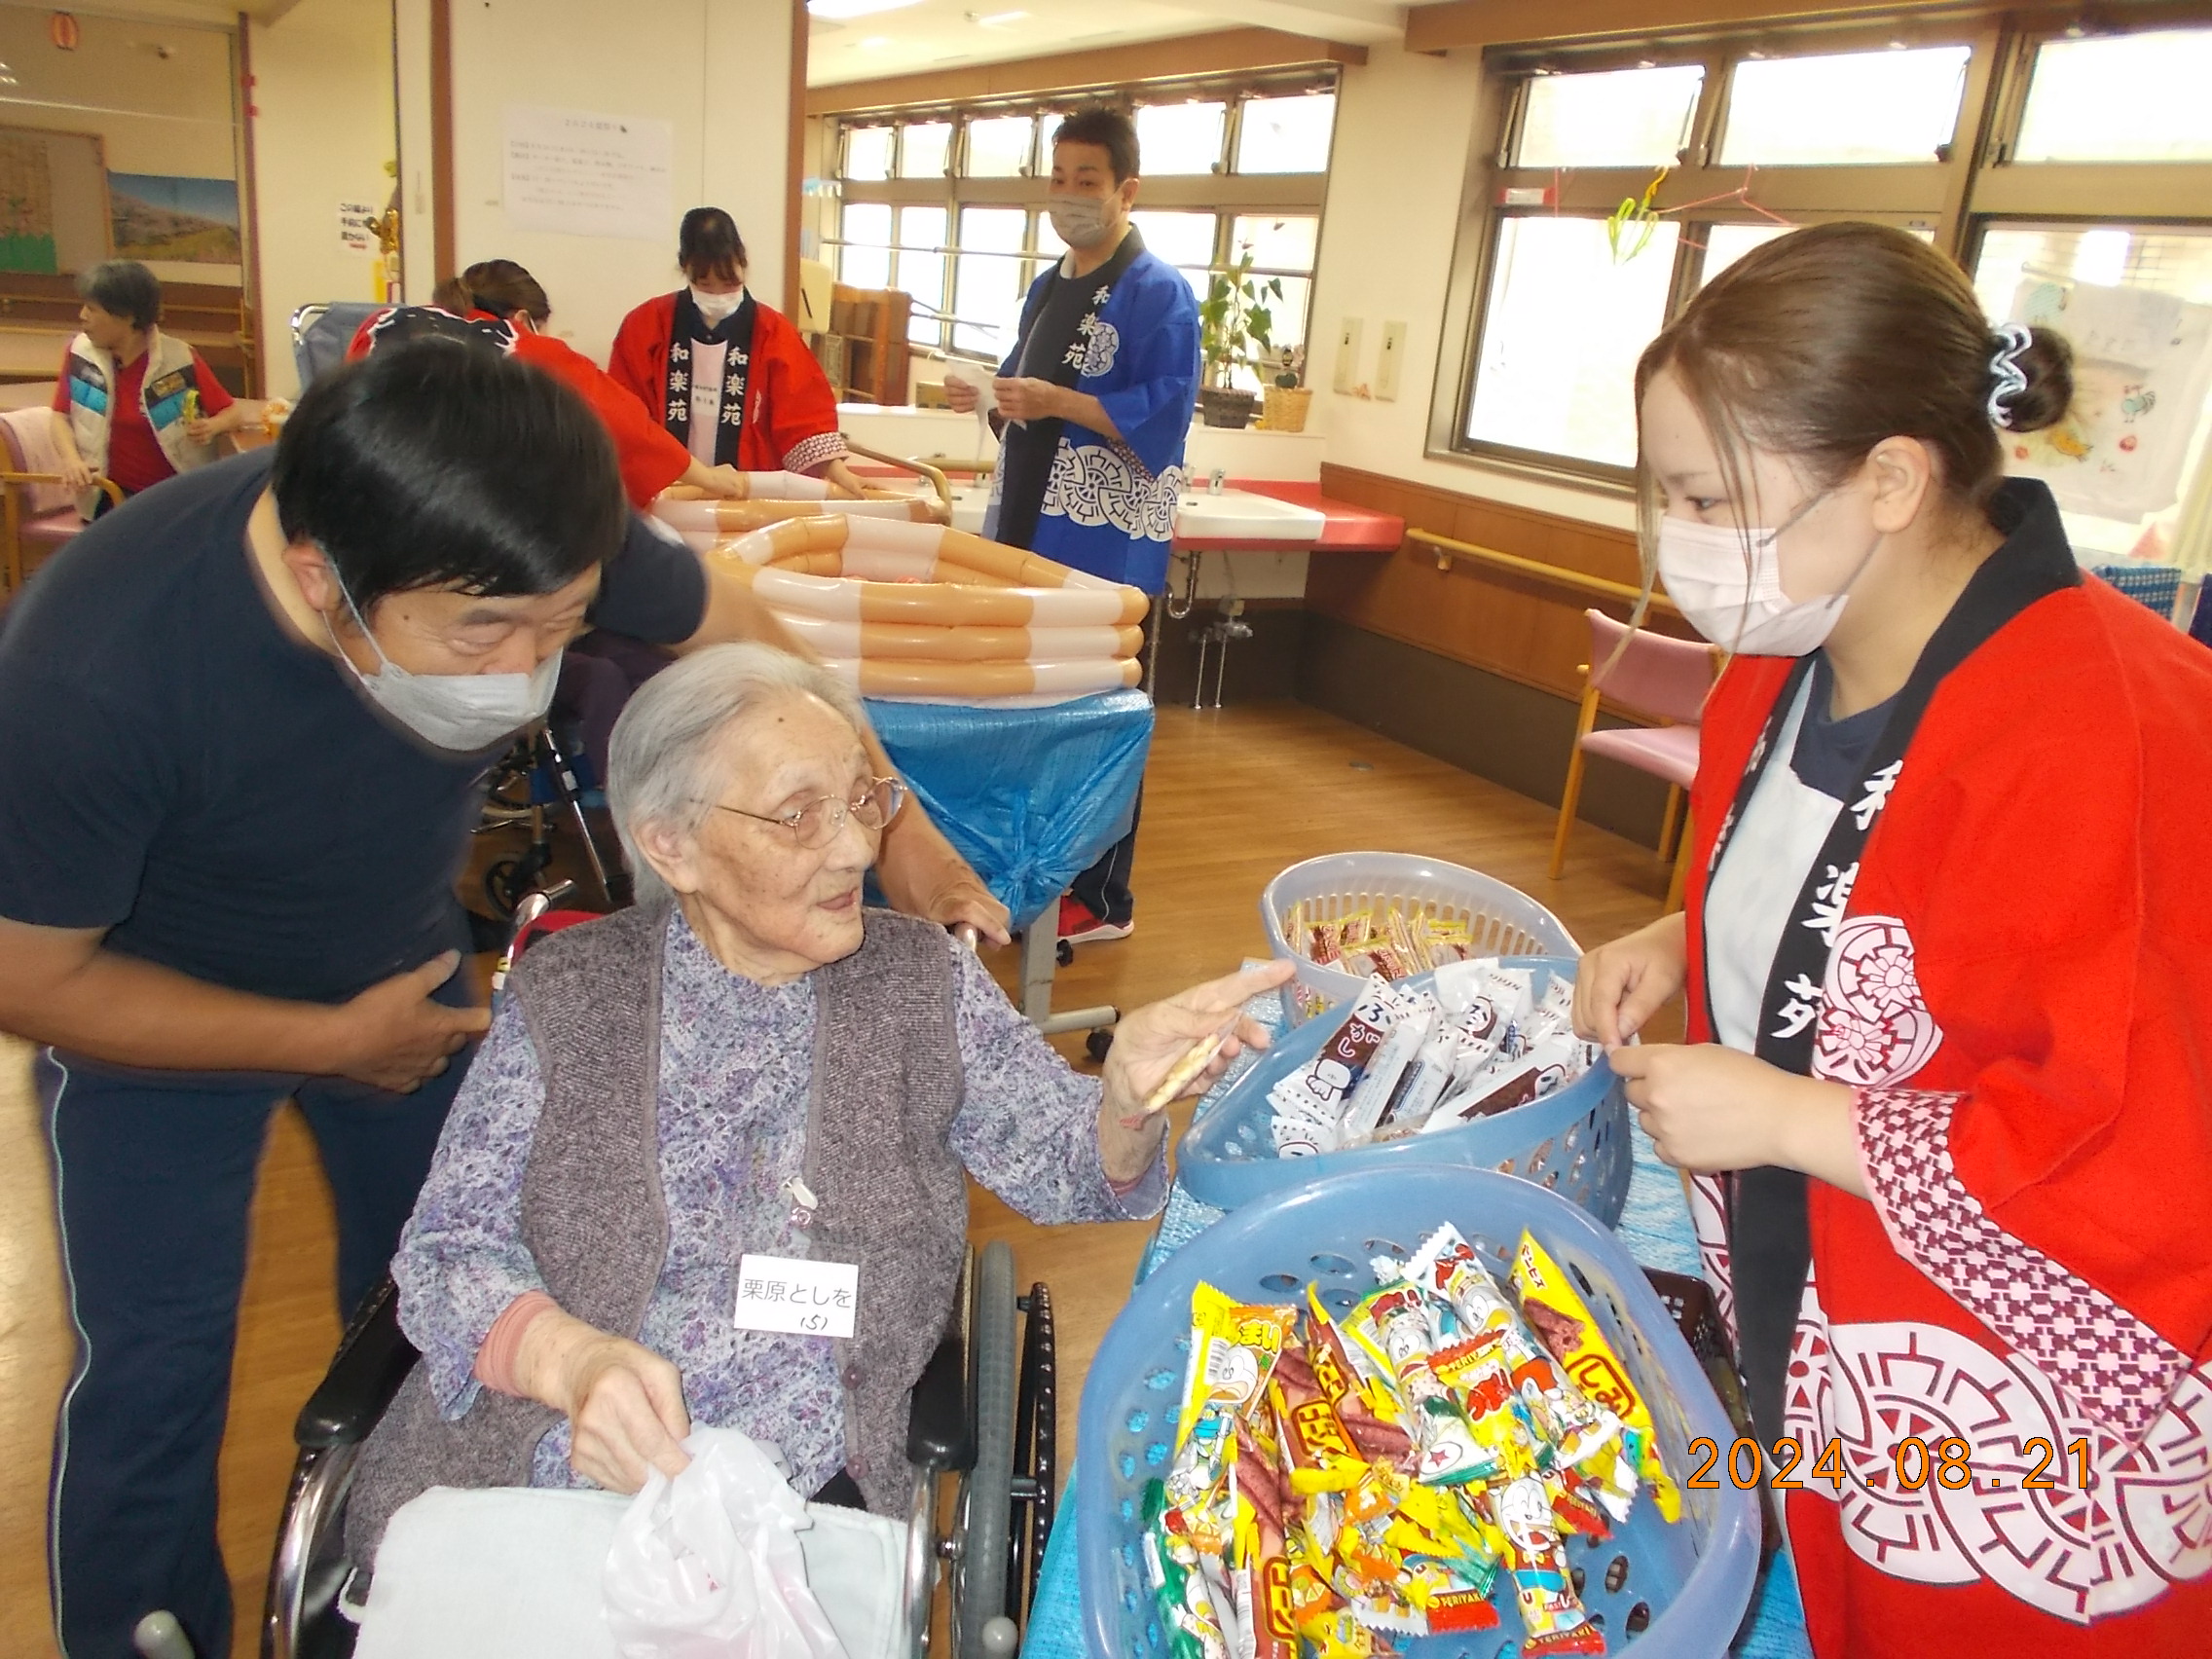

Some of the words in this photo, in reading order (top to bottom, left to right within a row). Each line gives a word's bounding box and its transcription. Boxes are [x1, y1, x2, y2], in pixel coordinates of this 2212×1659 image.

[1061, 285, 1111, 370] 和楽苑
[667, 342, 690, 422] 和楽苑
[720, 346, 750, 426] 和楽苑
[741, 1278, 852, 1309] 栗原としを
